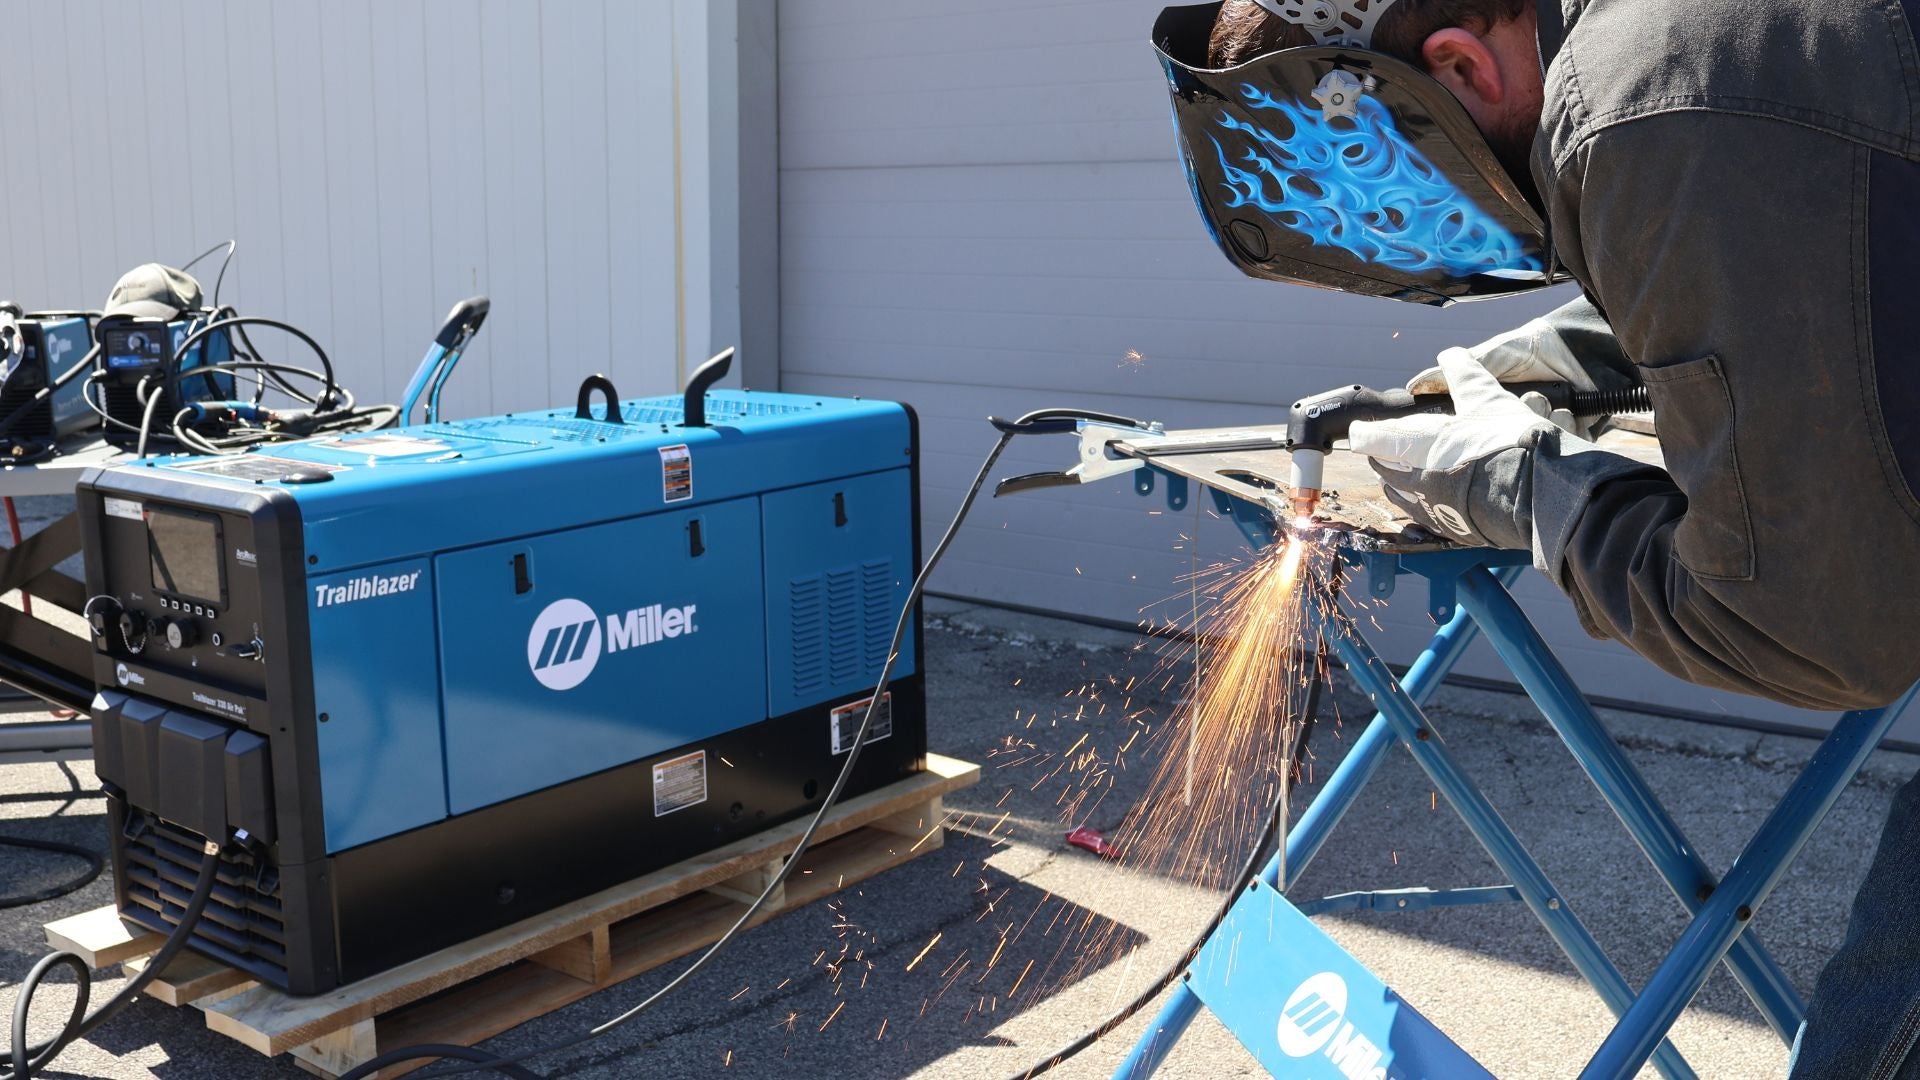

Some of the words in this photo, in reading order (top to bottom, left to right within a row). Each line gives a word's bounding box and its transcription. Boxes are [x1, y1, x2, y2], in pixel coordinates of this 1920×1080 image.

[1320, 402, 1341, 412] Miller
[316, 575, 419, 608] Trailblazer
[606, 604, 696, 654] Miller
